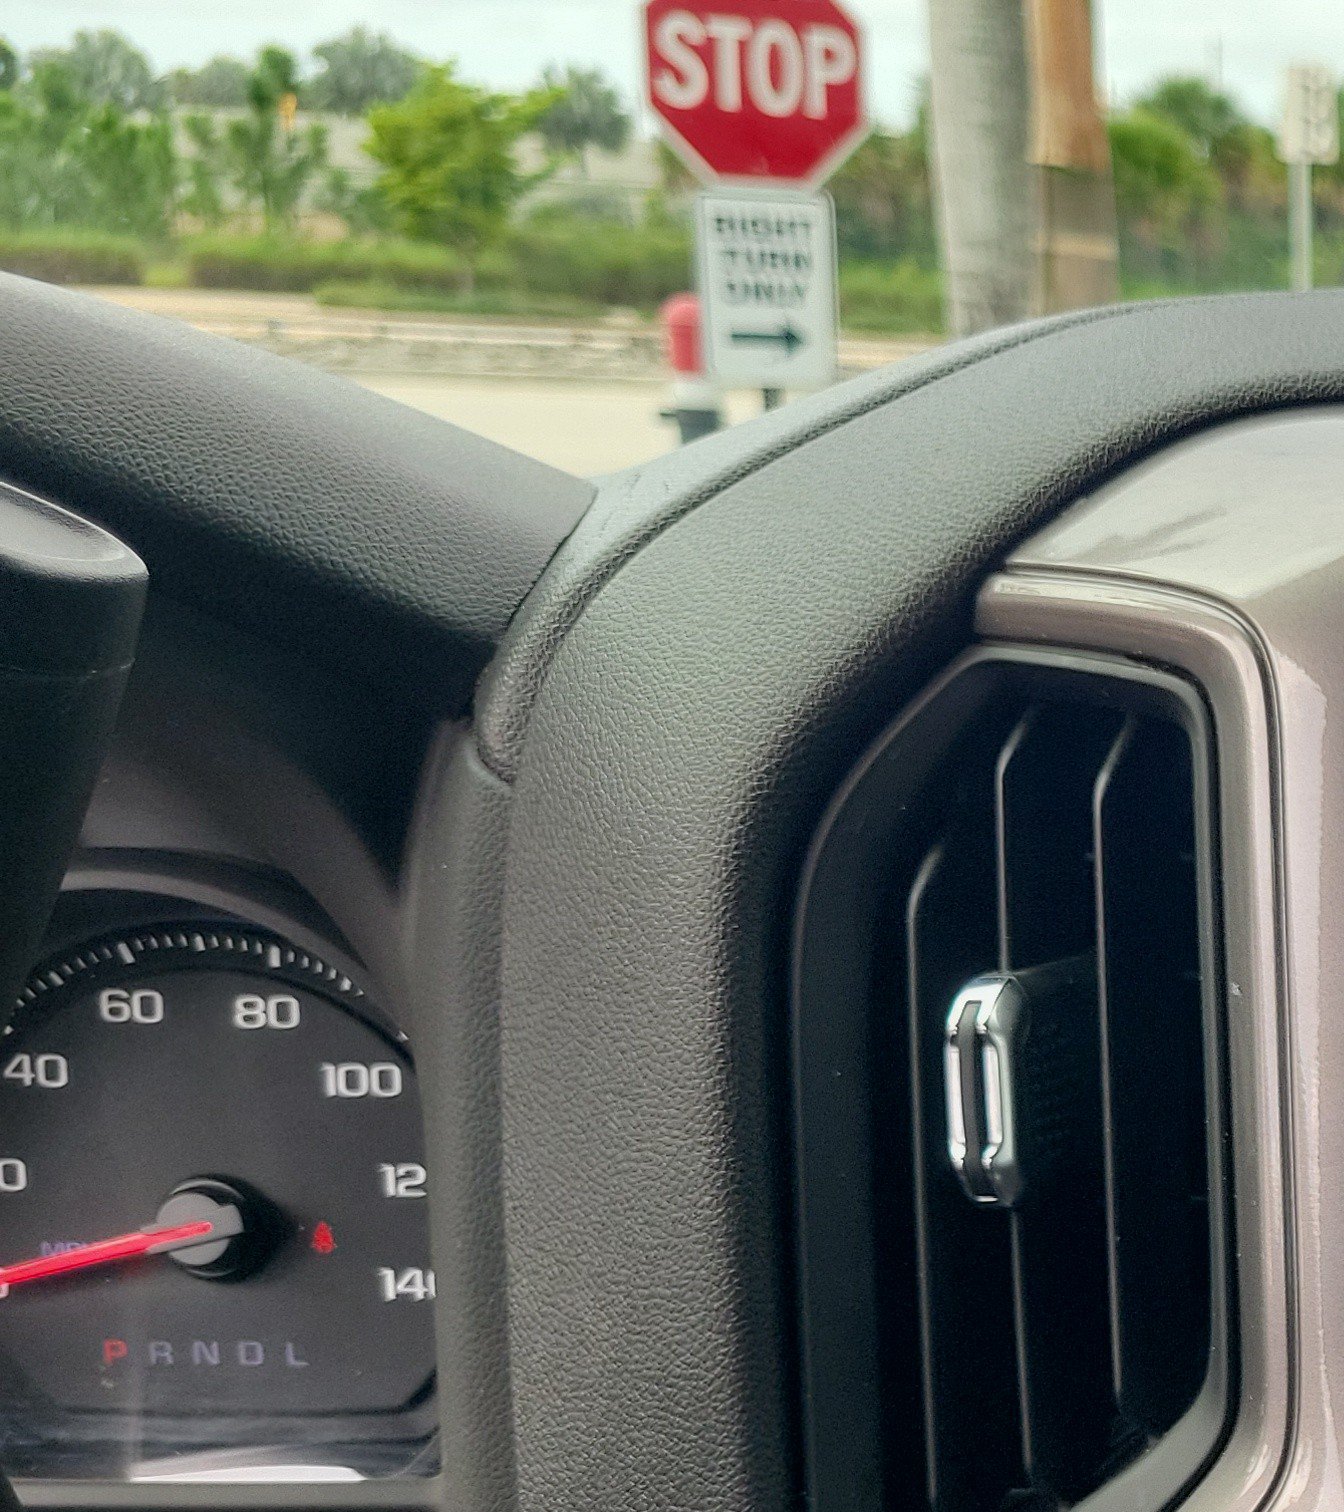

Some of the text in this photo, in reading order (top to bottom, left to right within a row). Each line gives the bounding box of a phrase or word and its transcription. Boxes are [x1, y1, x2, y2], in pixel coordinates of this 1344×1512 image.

[653, 8, 858, 121] STOP
[100, 989, 164, 1025] 60
[233, 994, 301, 1030] 80
[3, 1053, 69, 1089] 40
[320, 1062, 403, 1099] 100
[0, 1157, 27, 1193] 0
[379, 1162, 428, 1199] 12
[103, 1340, 309, 1367] P R N D L
